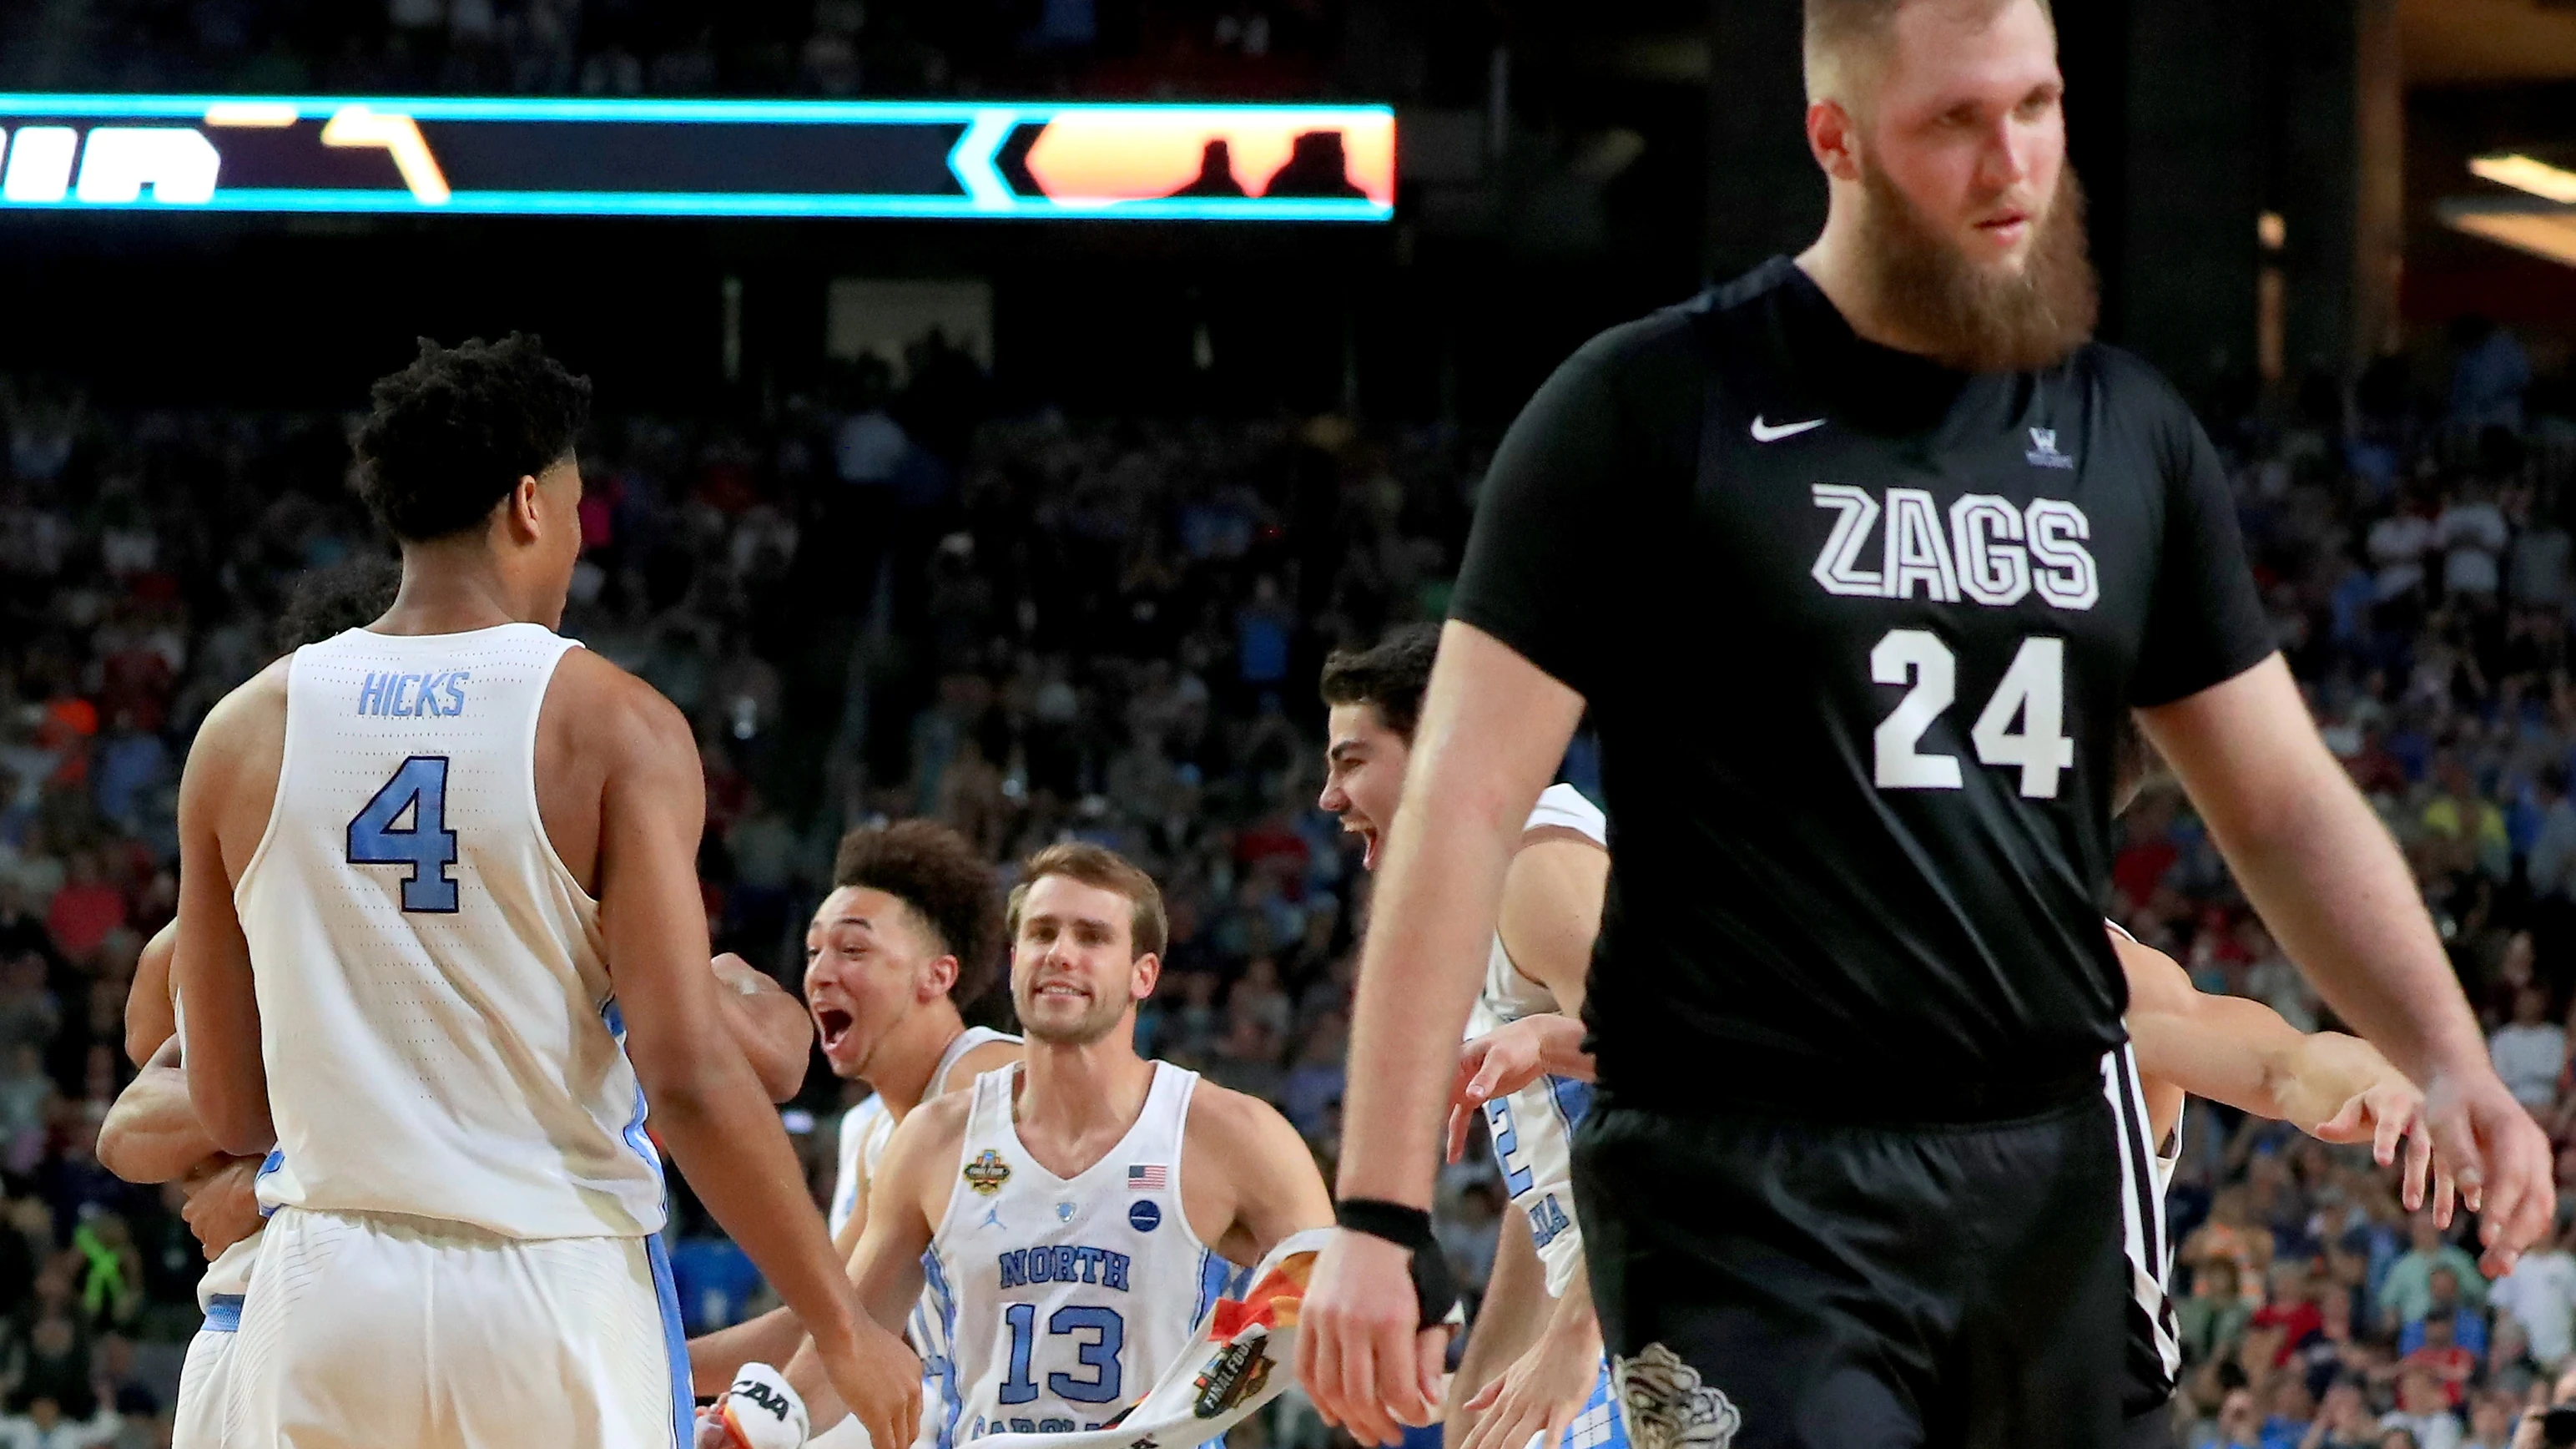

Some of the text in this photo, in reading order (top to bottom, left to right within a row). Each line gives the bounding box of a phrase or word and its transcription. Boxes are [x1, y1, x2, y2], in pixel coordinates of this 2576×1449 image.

[1811, 482, 2100, 610] ZAGS
[358, 671, 470, 717] HICKS
[1869, 629, 2073, 799] 24
[346, 755, 459, 913] 4
[999, 1245, 1130, 1292] NORTH
[1000, 1303, 1123, 1405] 13
[1203, 1342, 1252, 1410] FINAL FOU
